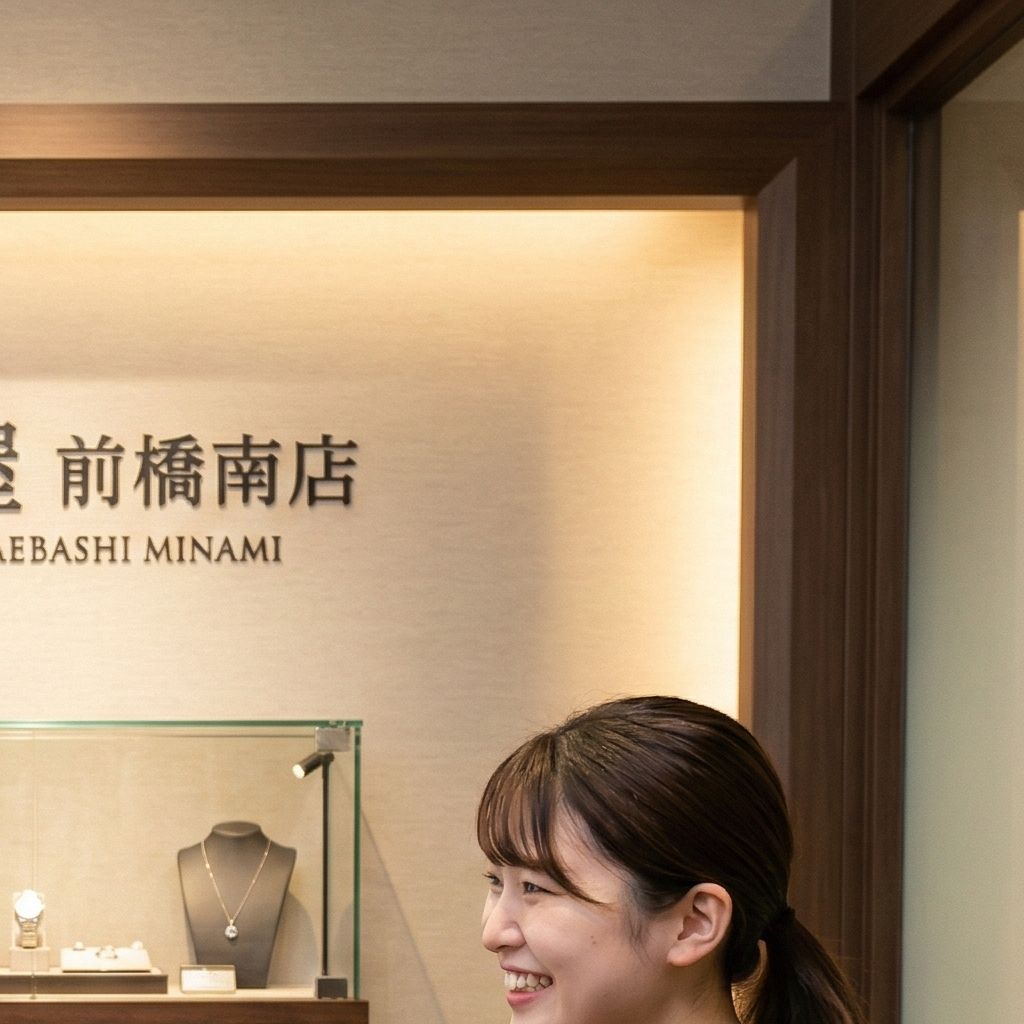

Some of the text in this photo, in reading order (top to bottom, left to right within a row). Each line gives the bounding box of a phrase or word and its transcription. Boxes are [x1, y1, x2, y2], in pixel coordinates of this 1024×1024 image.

[56, 434, 358, 507] 前橋南店
[144, 536, 283, 562] MINAMI
